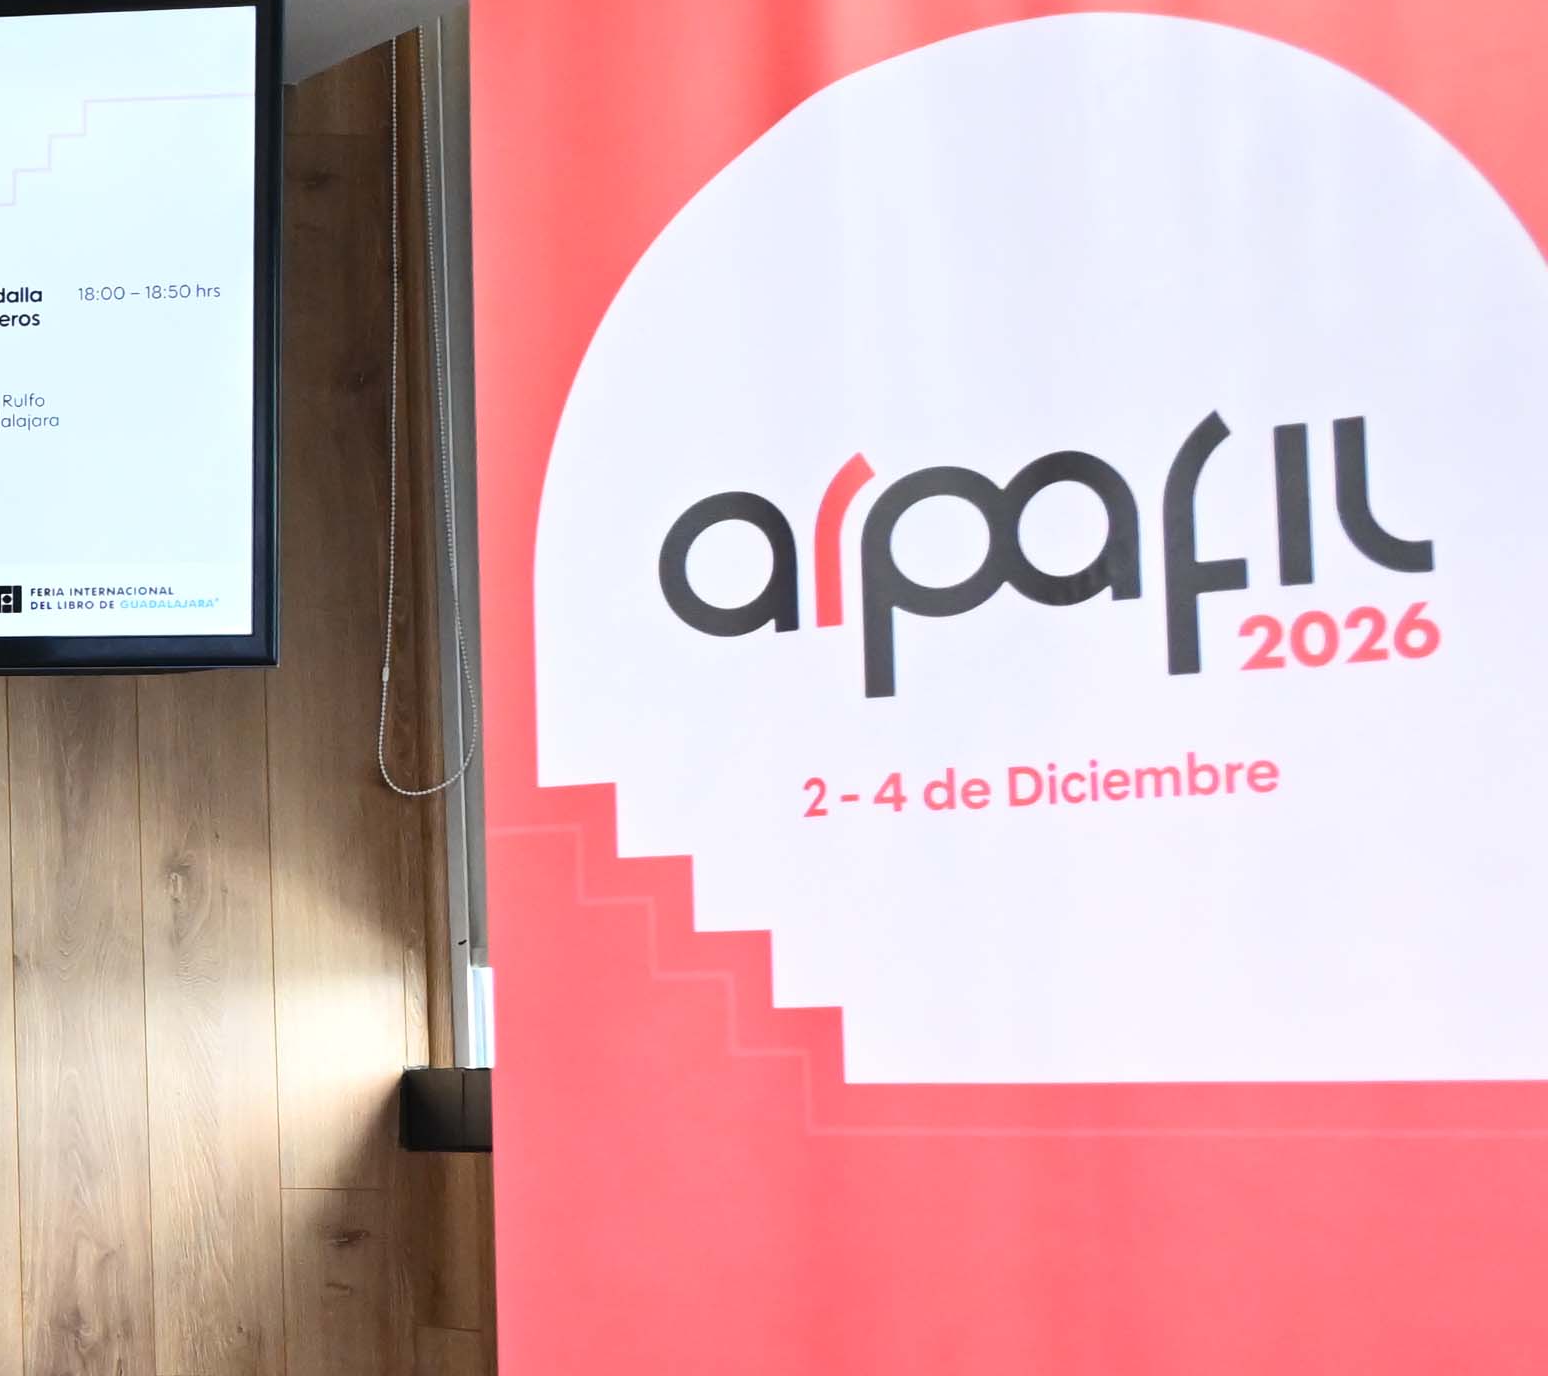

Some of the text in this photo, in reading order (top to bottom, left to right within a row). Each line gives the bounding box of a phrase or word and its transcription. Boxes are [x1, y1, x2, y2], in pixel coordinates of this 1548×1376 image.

[78, 286, 126, 302] 18:00
[145, 284, 191, 300] 18:50
[196, 283, 221, 299] hrs
[3, 392, 46, 408] Rulfo
[30, 586, 174, 597] FERIA INTERNACIONAL
[30, 600, 53, 610] DEL
[57, 600, 95, 610] LIBRO
[99, 600, 115, 609] DE
[1237, 601, 1442, 672] 2026
[802, 778, 829, 819] 2
[873, 772, 907, 813] 4
[923, 766, 992, 813] de
[1006, 751, 1280, 808] Diciembre
